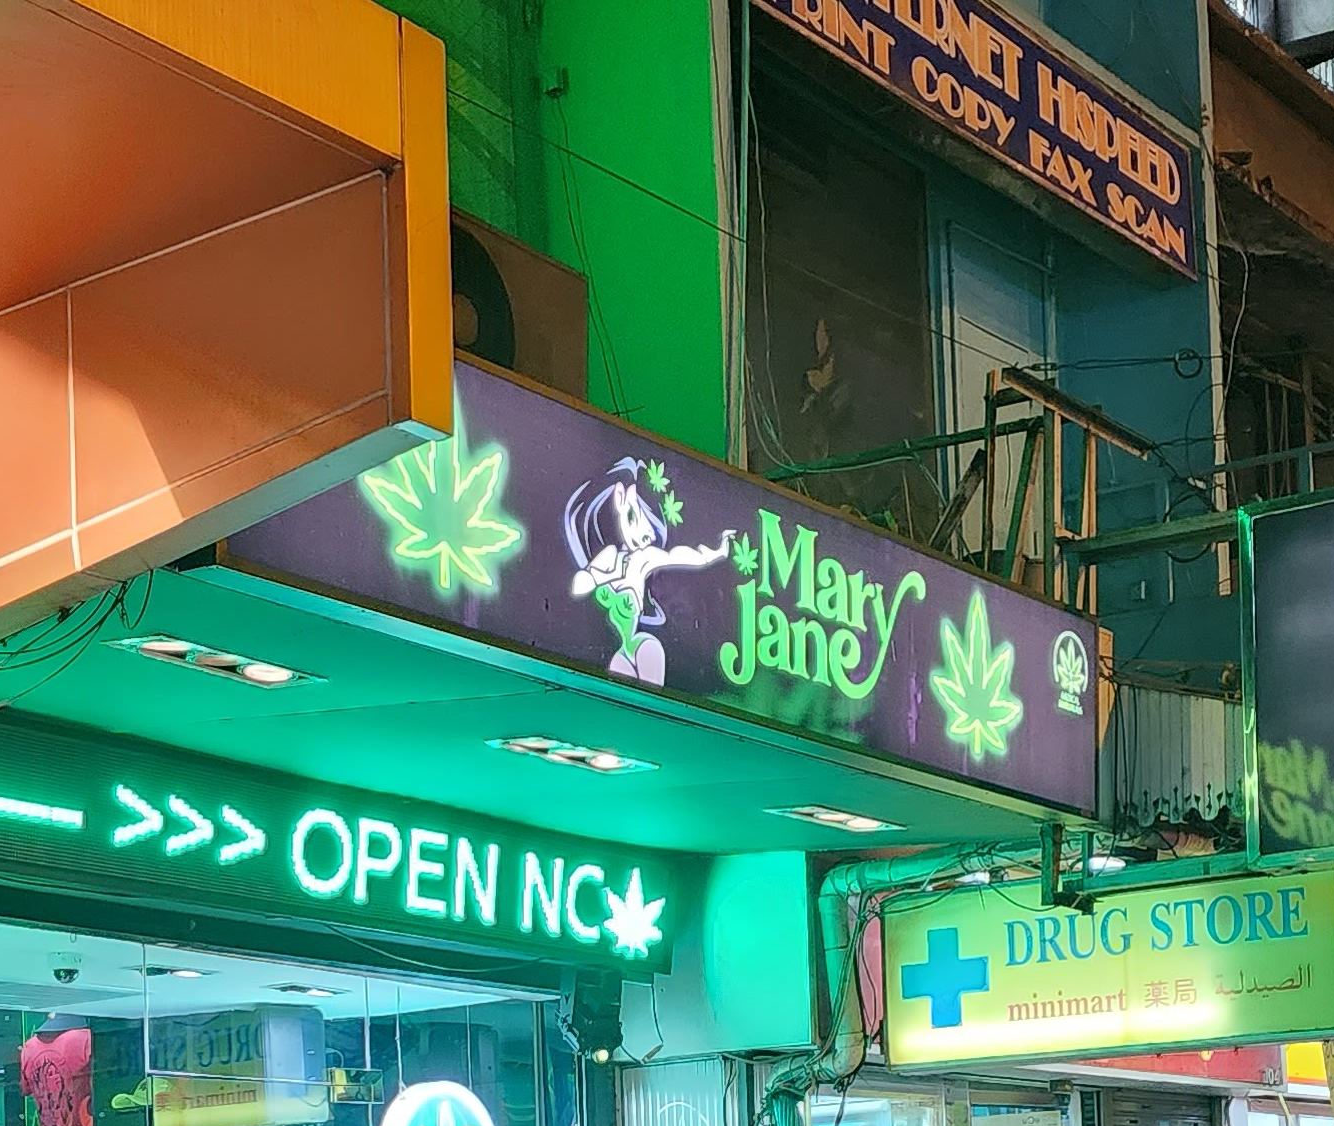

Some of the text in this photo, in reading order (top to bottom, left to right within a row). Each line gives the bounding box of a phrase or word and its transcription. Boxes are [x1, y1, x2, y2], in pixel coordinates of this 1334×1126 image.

[791, 0, 1187, 262] RINT COPY FAX SCAN
[1037, 60, 1181, 205] HISPEED
[756, 508, 926, 655] Mary
[291, 808, 500, 926] OPEN
[1003, 886, 1309, 967] DRUG STORE
[1007, 989, 1127, 1022] minimart
